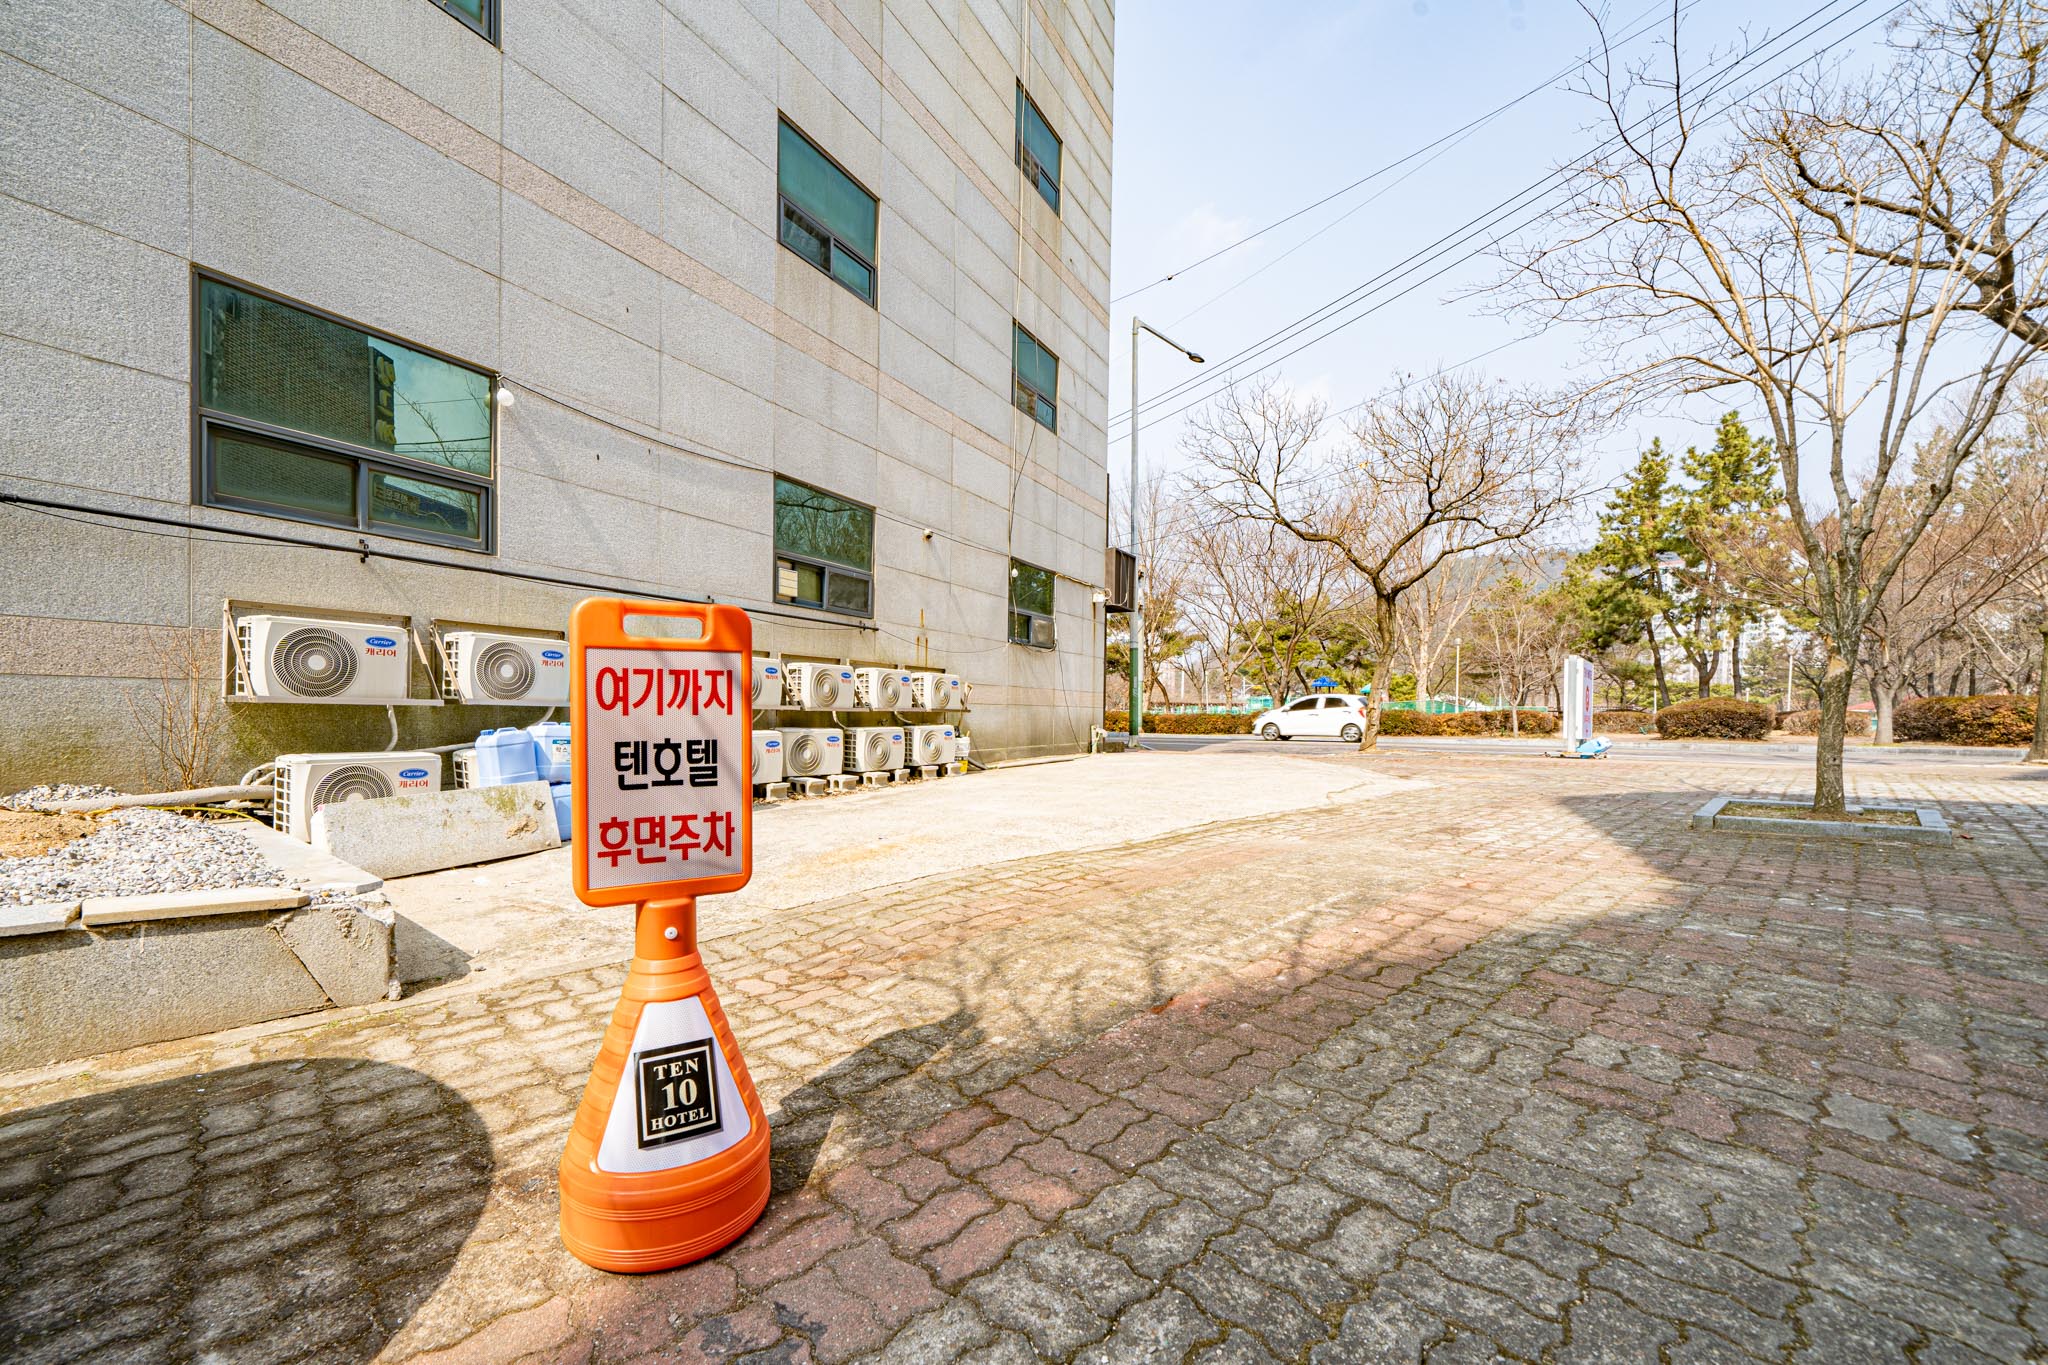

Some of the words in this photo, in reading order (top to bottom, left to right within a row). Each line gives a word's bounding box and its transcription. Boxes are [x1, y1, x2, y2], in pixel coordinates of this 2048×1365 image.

[364, 647, 397, 657] 캐리어
[367, 638, 393, 648] Carrier
[595, 666, 733, 717] 여기까지
[401, 768, 427, 779] Carrier
[614, 737, 718, 791] 텐호텔
[398, 779, 429, 789] 캐리어
[597, 811, 735, 868] 후면주차
[653, 1057, 699, 1081] TEN
[661, 1078, 697, 1111] 10
[650, 1107, 709, 1131] HOTEL
